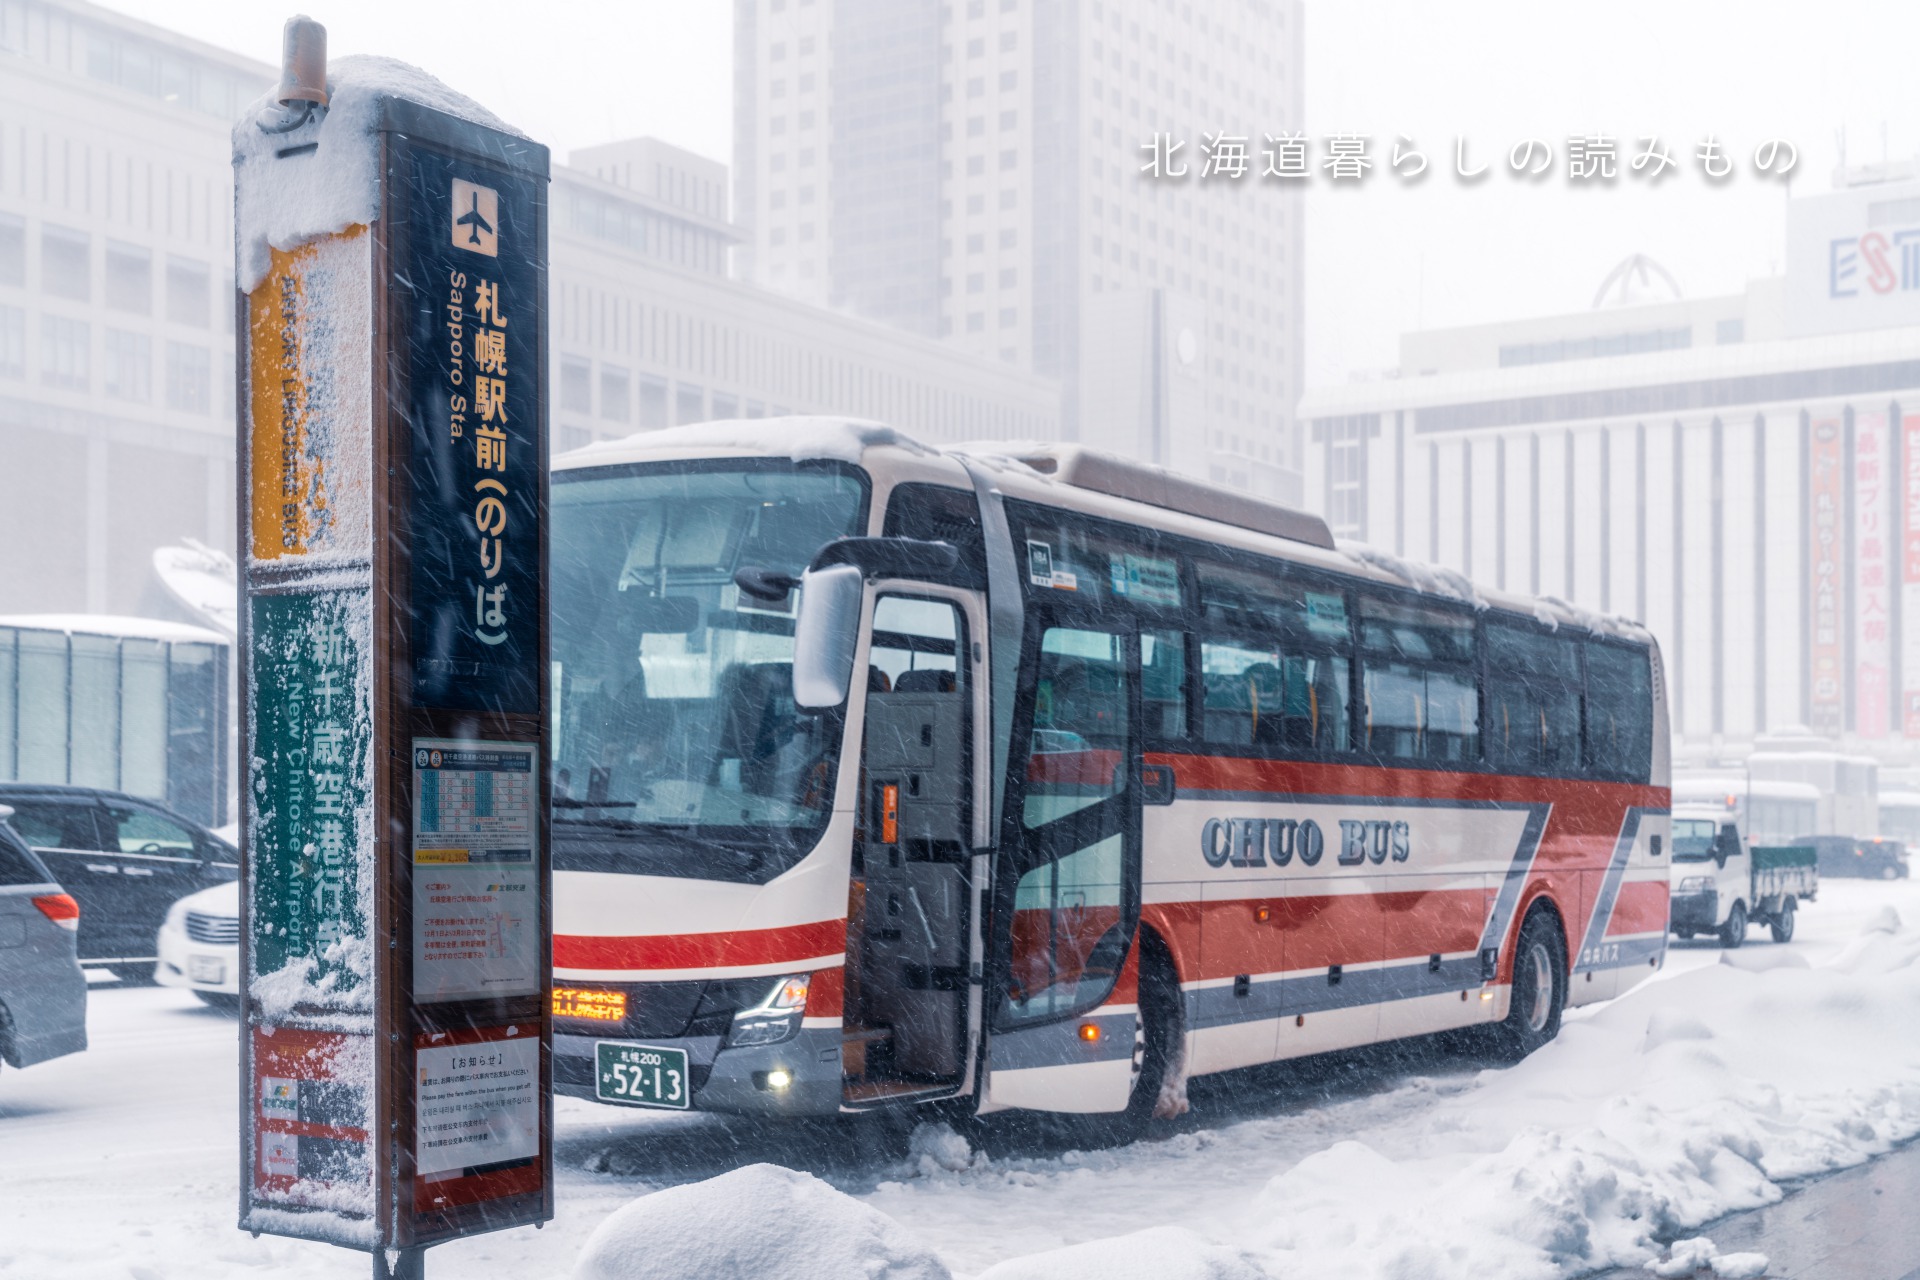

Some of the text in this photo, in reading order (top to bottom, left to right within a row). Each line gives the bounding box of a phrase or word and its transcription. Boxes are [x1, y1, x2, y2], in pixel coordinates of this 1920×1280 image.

[449, 270, 467, 446] Sapporo Sta.
[281, 276, 298, 548] AIRPORT LIMOUSINE BUS
[288, 682, 304, 738] New
[288, 748, 304, 853] Chitose
[1201, 816, 1411, 869] CHUO BUS
[288, 861, 304, 957] Airport
[1582, 944, 1620, 965] 中央バス
